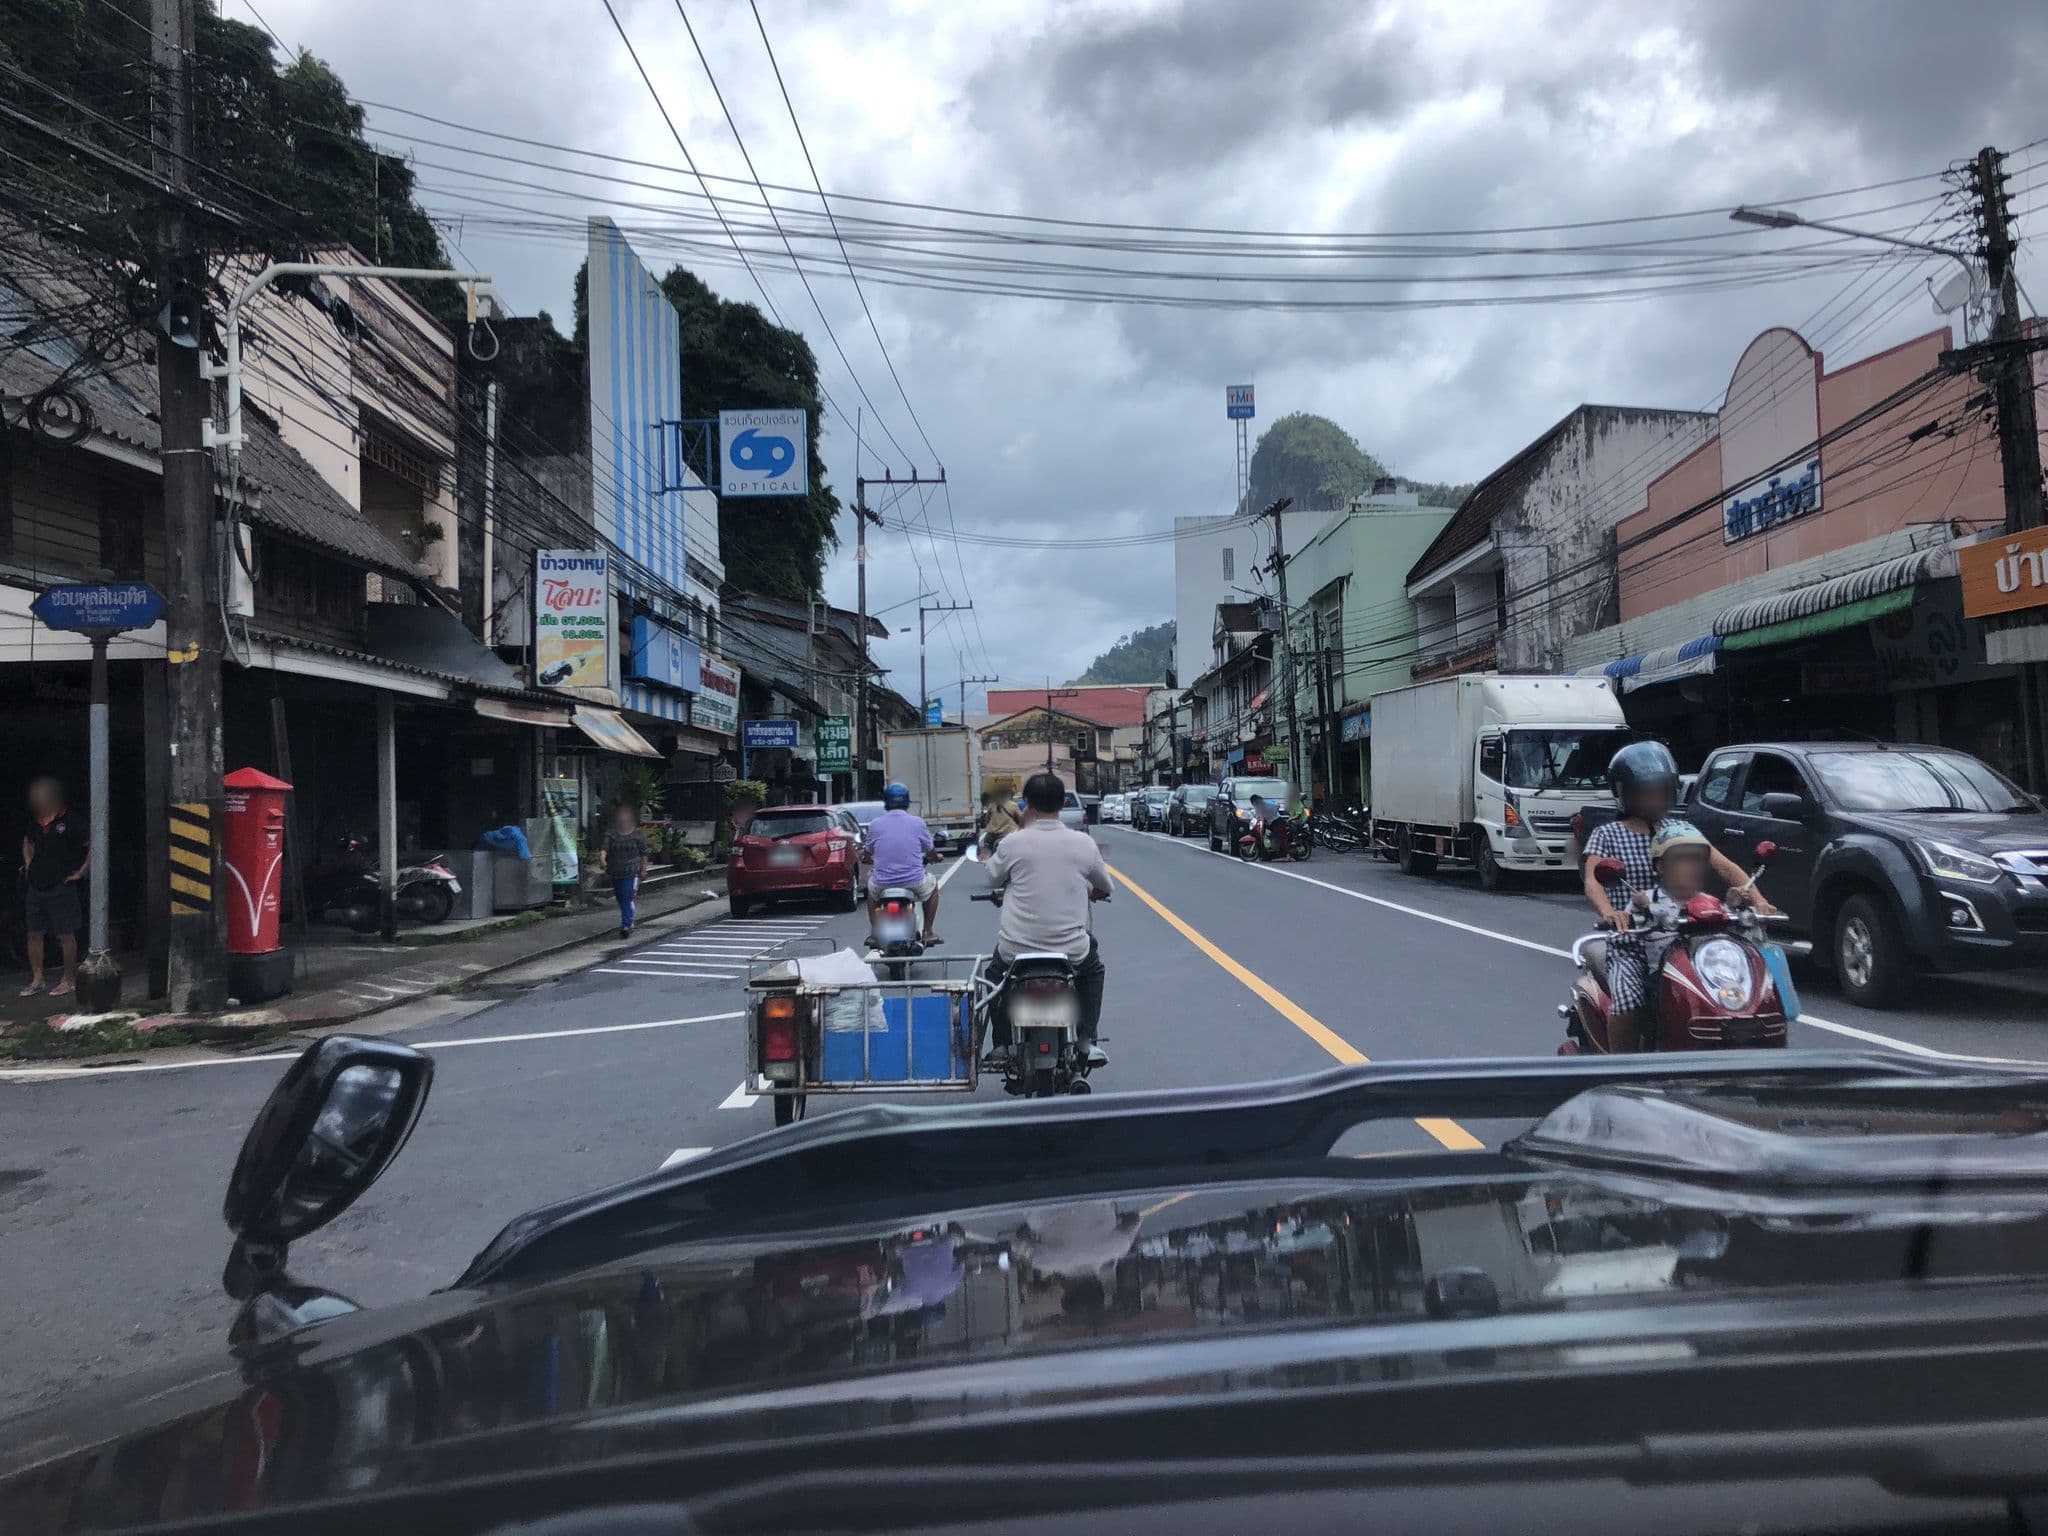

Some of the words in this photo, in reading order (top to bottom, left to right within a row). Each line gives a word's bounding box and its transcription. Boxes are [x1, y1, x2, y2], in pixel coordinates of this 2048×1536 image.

[728, 481, 800, 492] OPTICAL
[540, 553, 606, 576] ข้าวขาหมู
[1994, 542, 2048, 593] บ้า
[818, 725, 849, 740] หมอ
[819, 740, 849, 759] เล็ก
